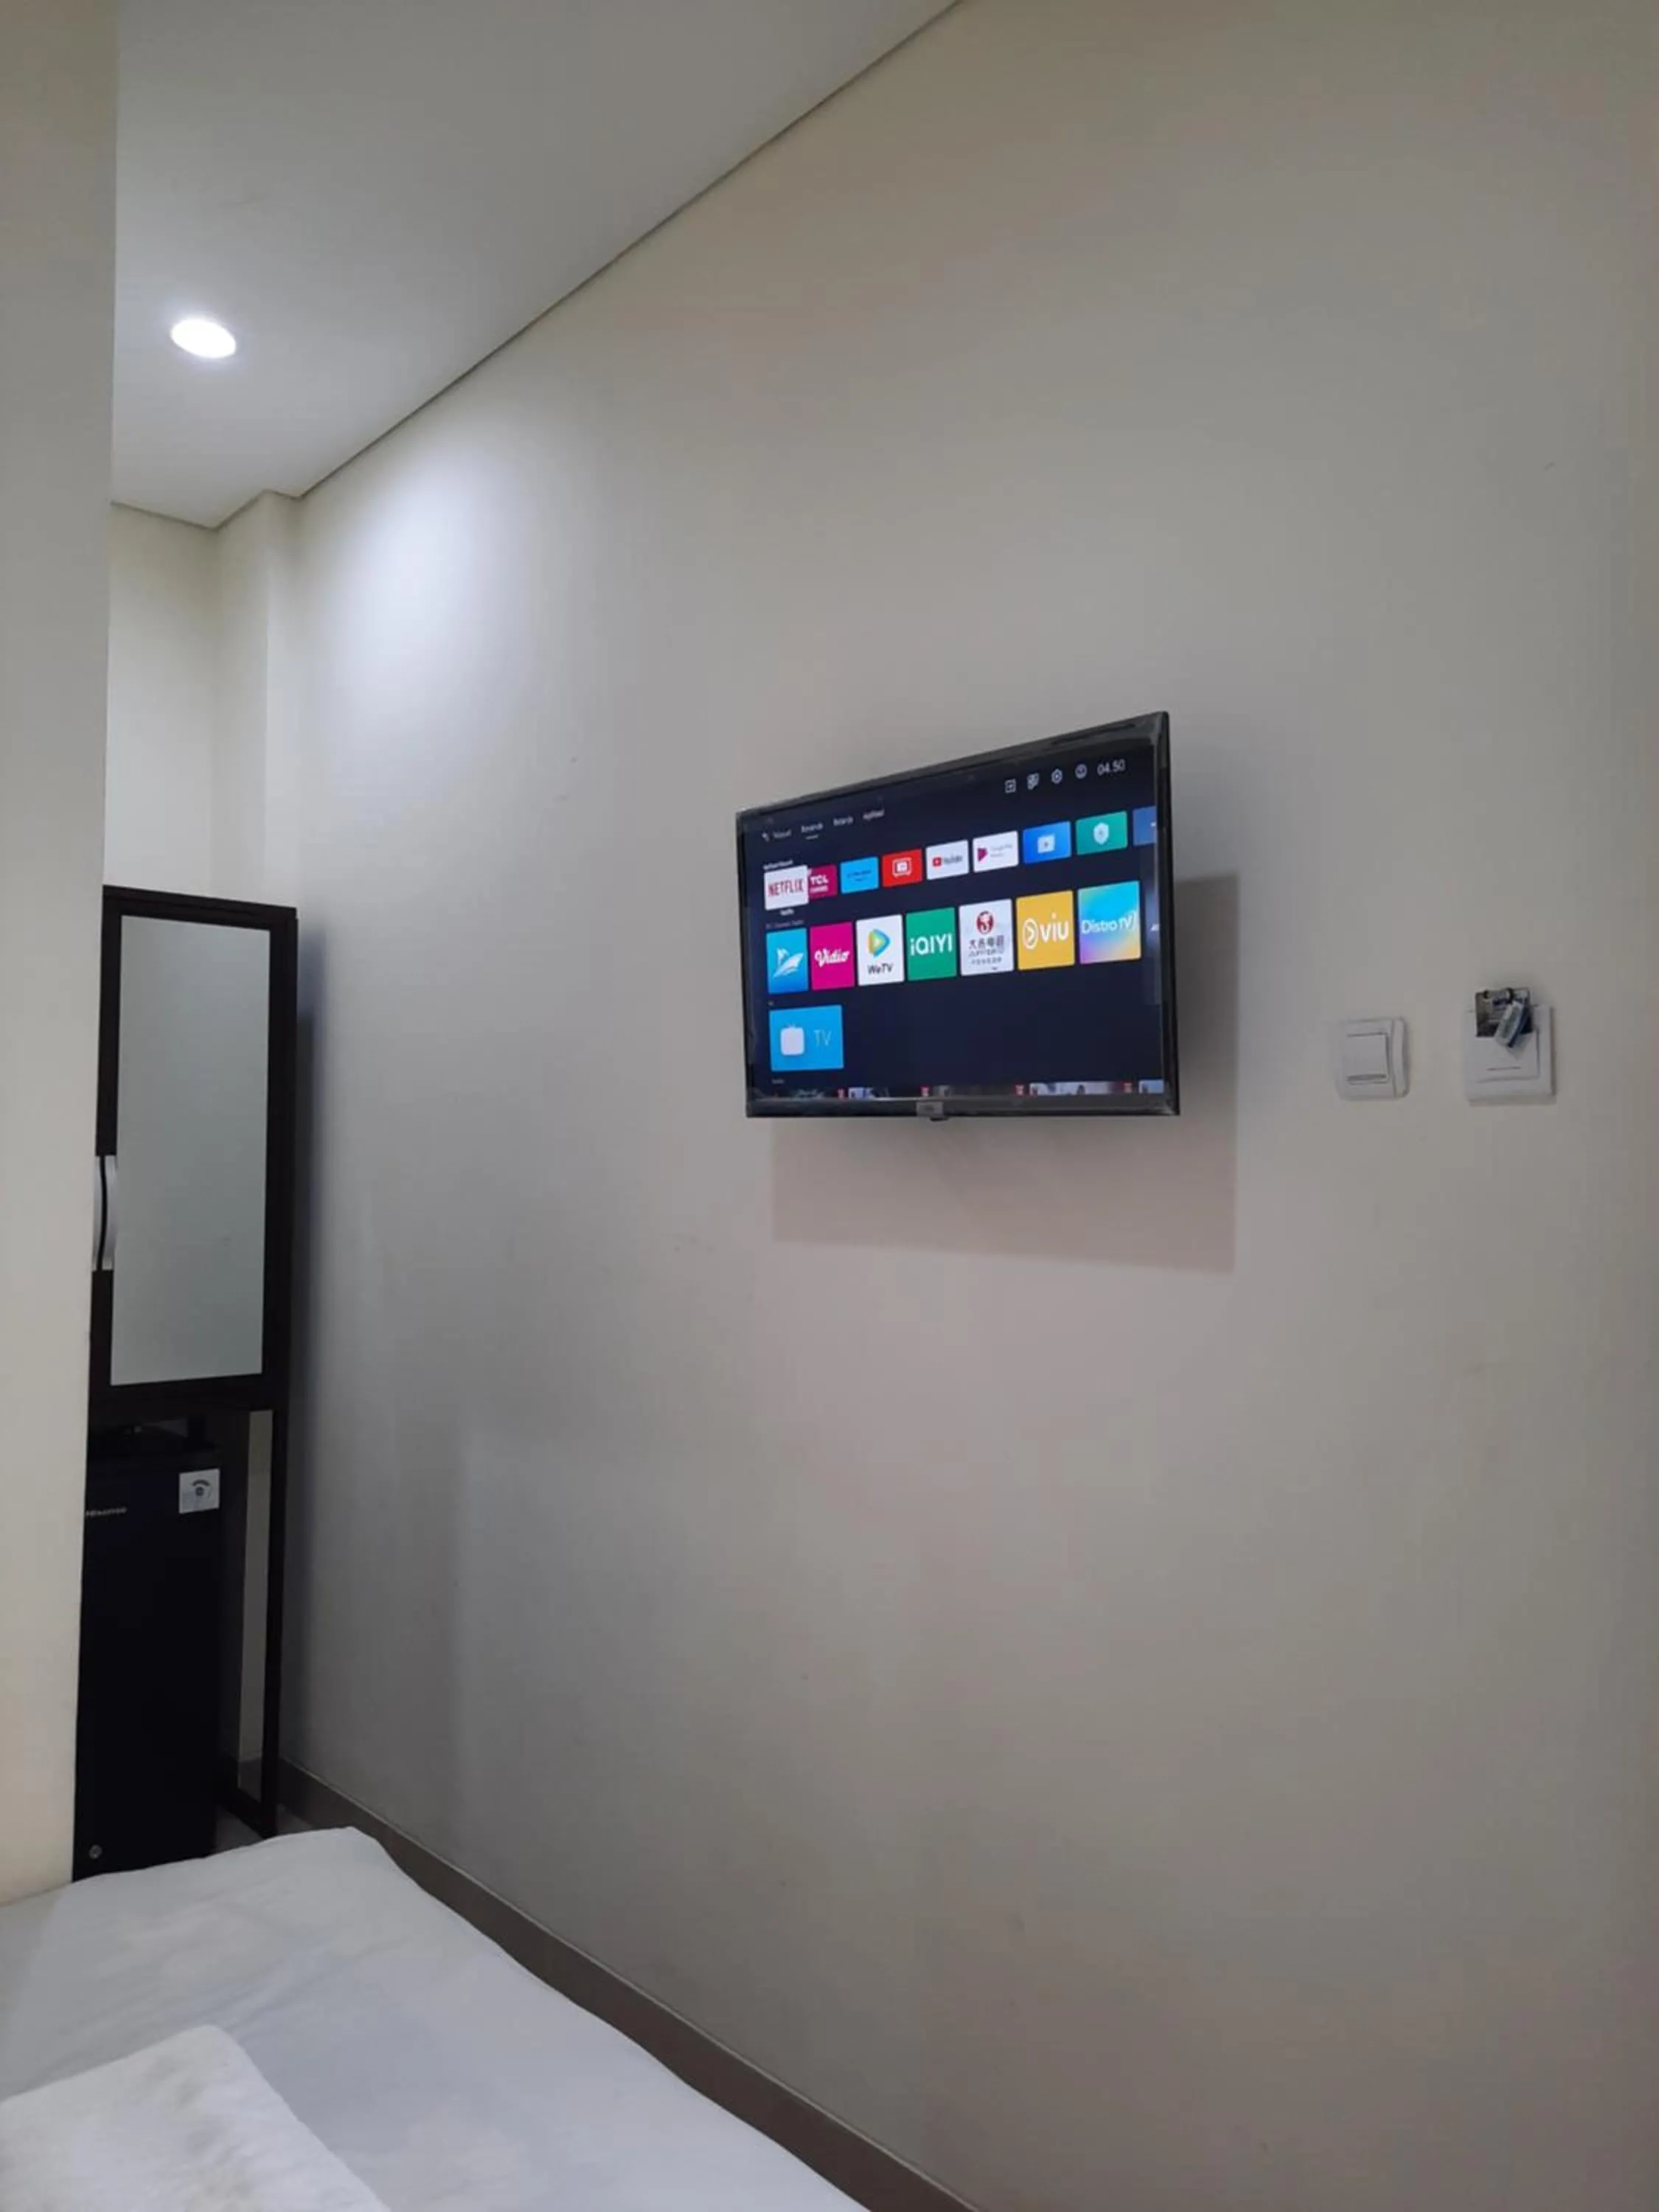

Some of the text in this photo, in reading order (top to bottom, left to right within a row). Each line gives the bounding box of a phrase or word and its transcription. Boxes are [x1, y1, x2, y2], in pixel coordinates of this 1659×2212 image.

[1096, 759, 1126, 775] 04.50
[768, 879, 804, 897] NETFLIX
[810, 874, 830, 885] TCL
[1040, 912, 1069, 943] viu
[910, 933, 953, 956] iQIYI
[814, 948, 850, 967] Vidio
[867, 963, 894, 975] WeTV
[813, 1030, 832, 1047] TV
